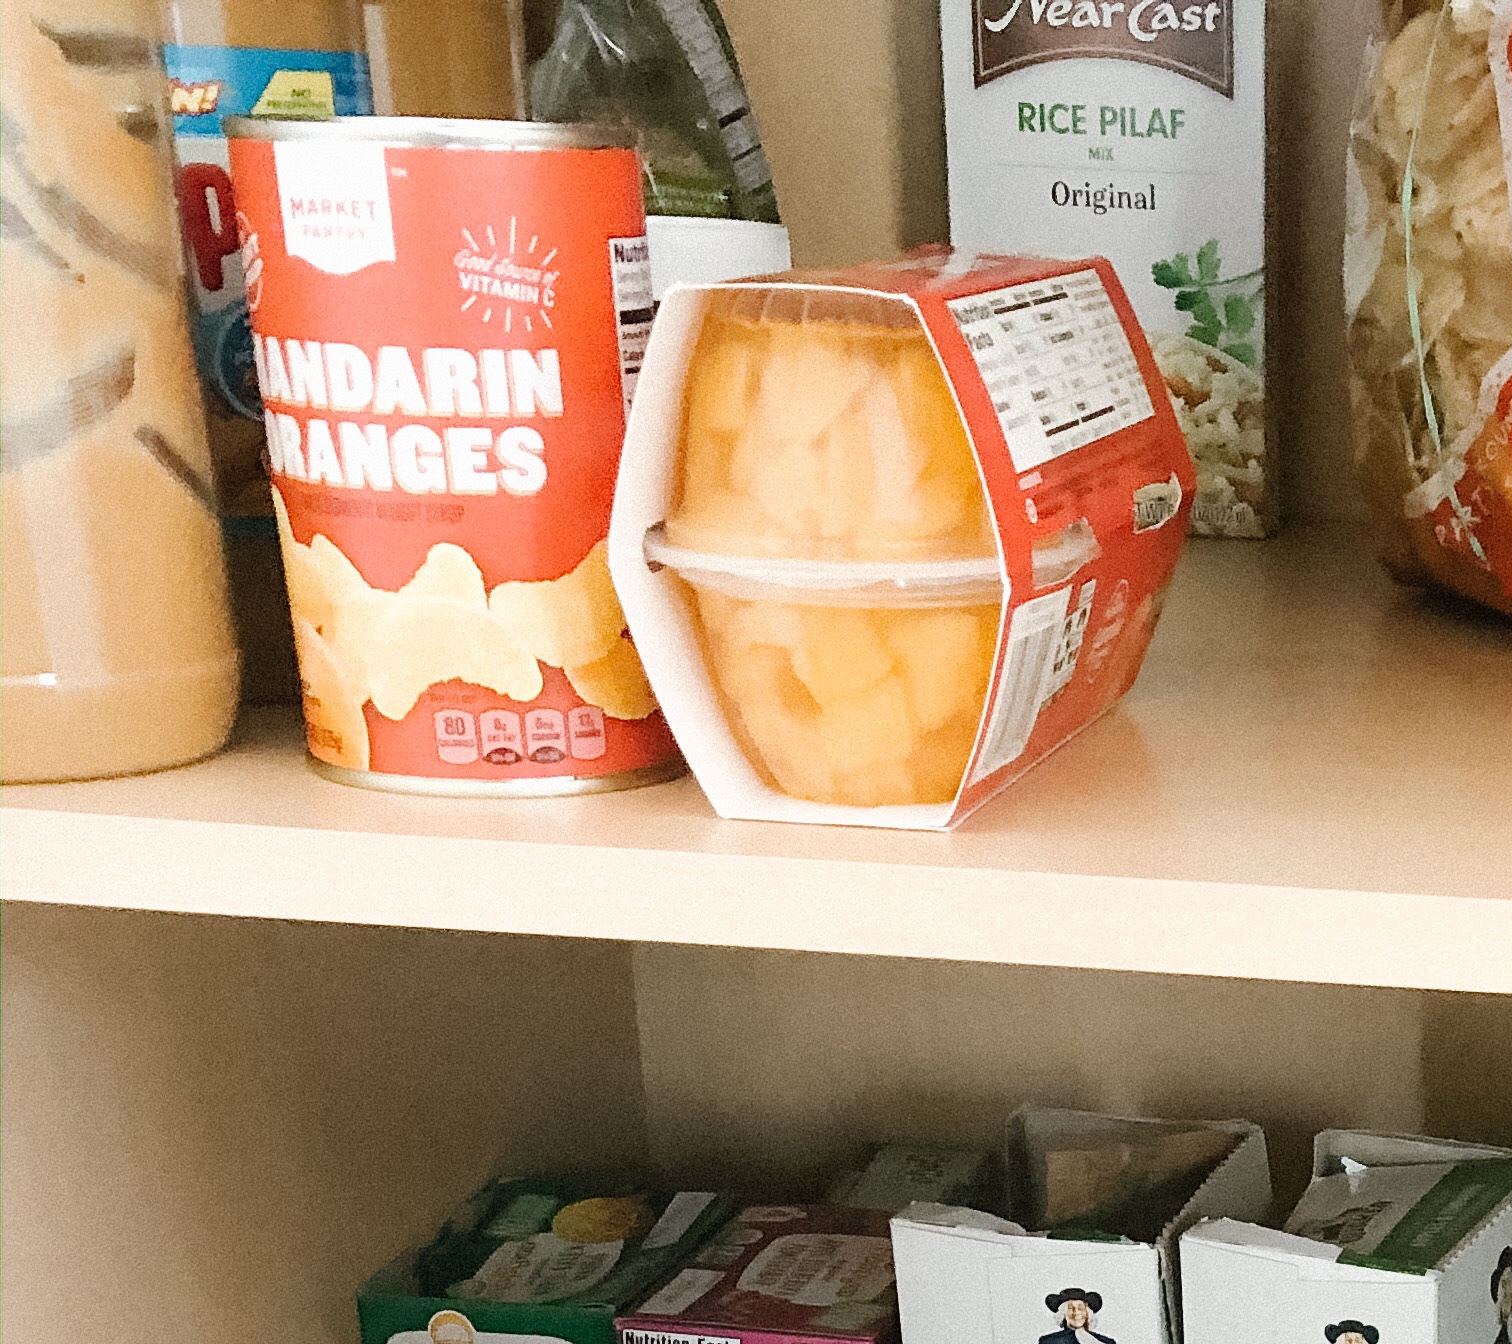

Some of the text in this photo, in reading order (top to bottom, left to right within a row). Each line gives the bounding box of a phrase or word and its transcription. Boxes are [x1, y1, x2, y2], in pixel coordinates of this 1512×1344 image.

[1017, 102, 1187, 140] RICE PILAF
[1087, 147, 1115, 162] MIX
[289, 196, 378, 222] MARKET
[1050, 181, 1157, 215] Original
[459, 273, 557, 309] VITAMIN C
[255, 334, 565, 419] ANDARIN
[266, 411, 550, 497] RANGES
